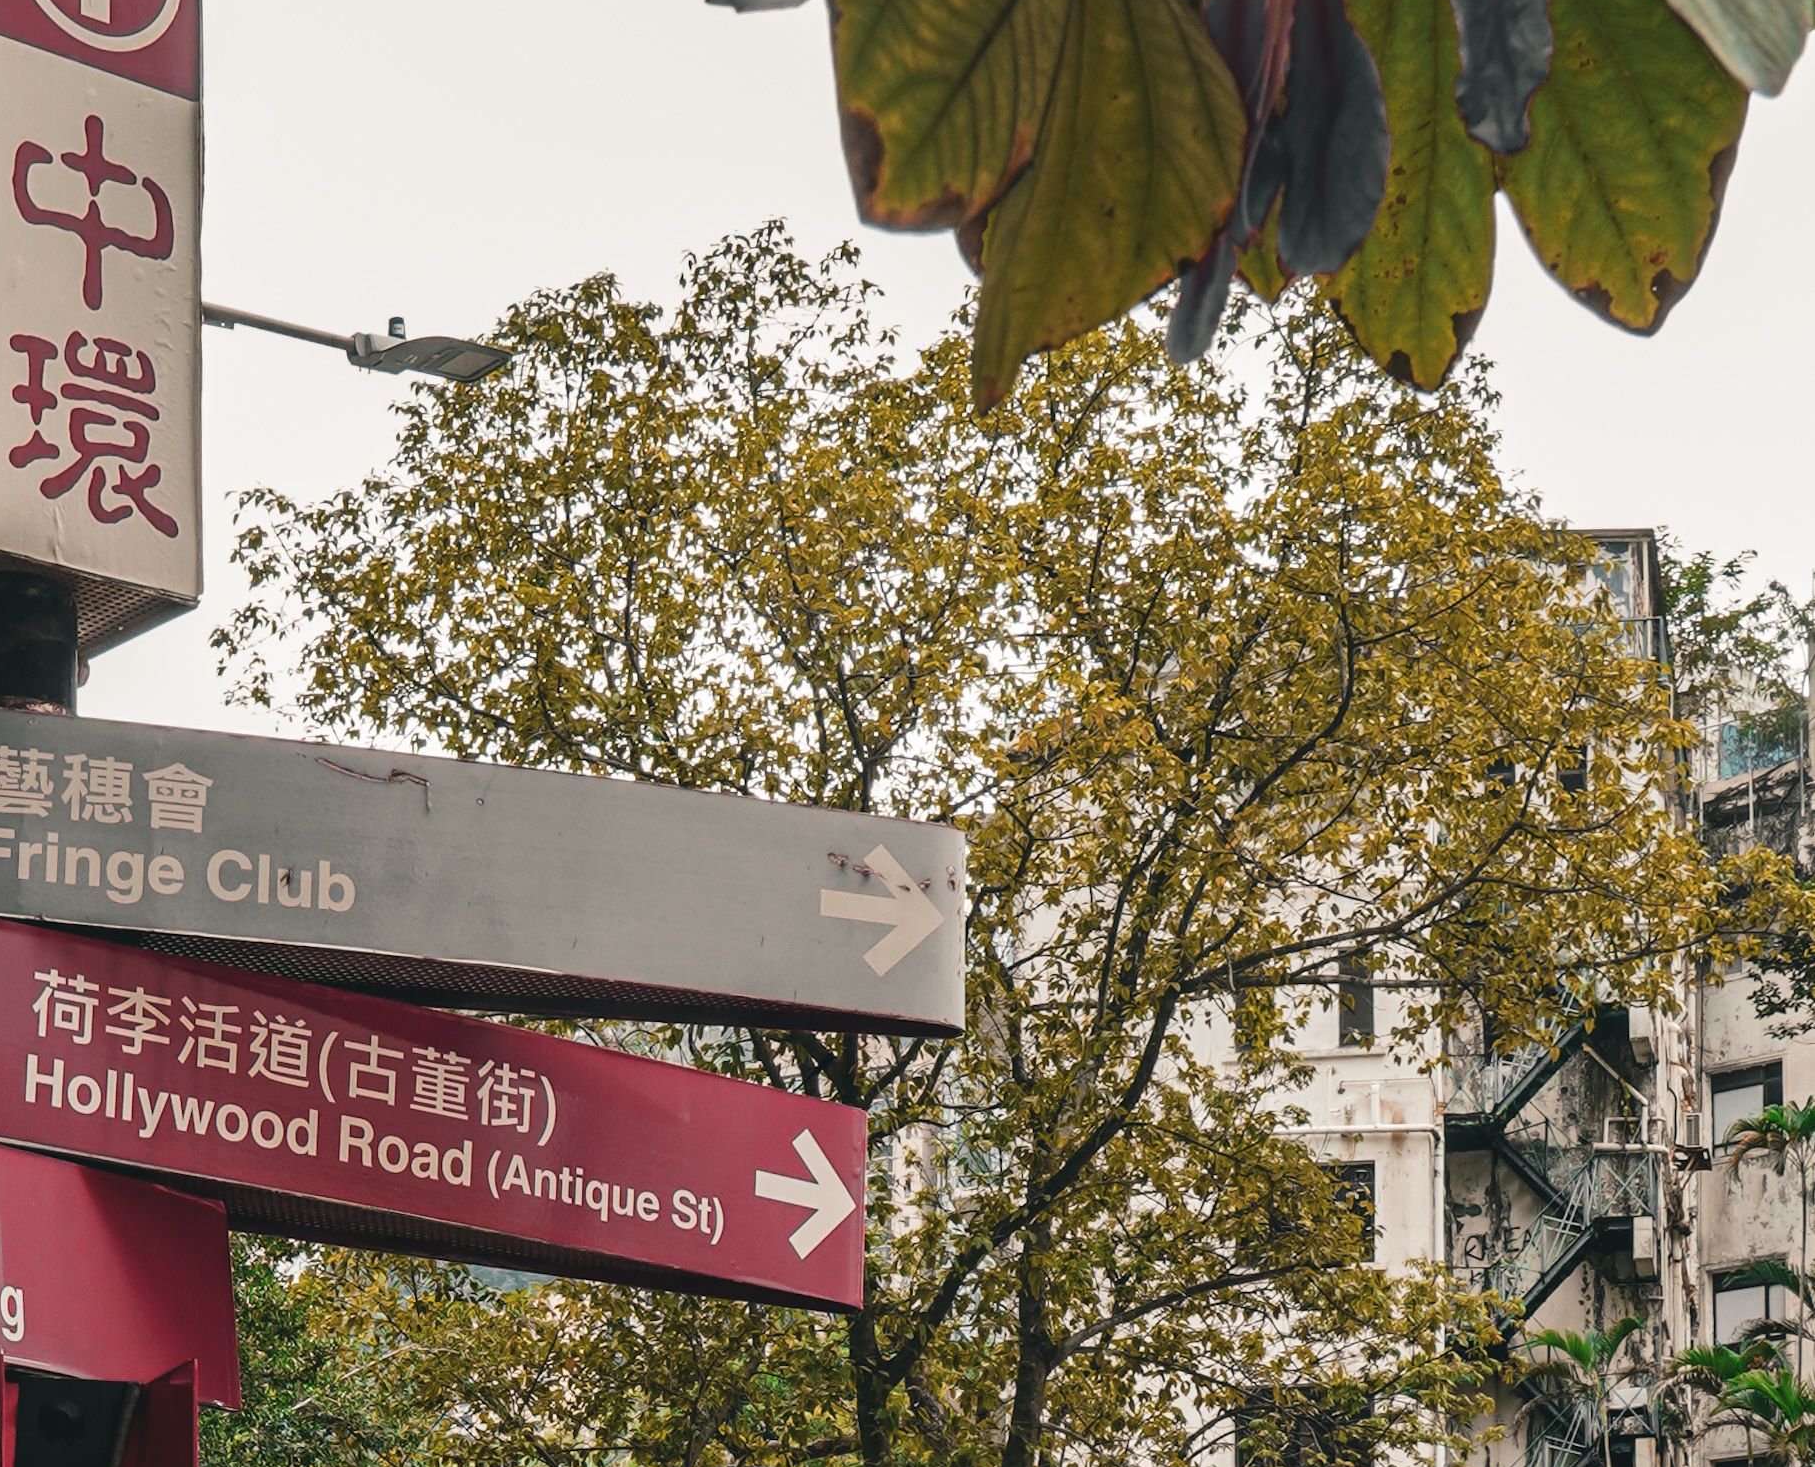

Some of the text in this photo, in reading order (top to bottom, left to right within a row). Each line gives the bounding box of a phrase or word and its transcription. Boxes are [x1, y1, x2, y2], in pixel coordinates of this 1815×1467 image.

[9, 114, 178, 538] 中環
[206, 848, 357, 913] Club
[23, 1052, 725, 1246] Hollywood Road (Antique St)
[32, 968, 557, 1146] 荷李活道(古董街)
